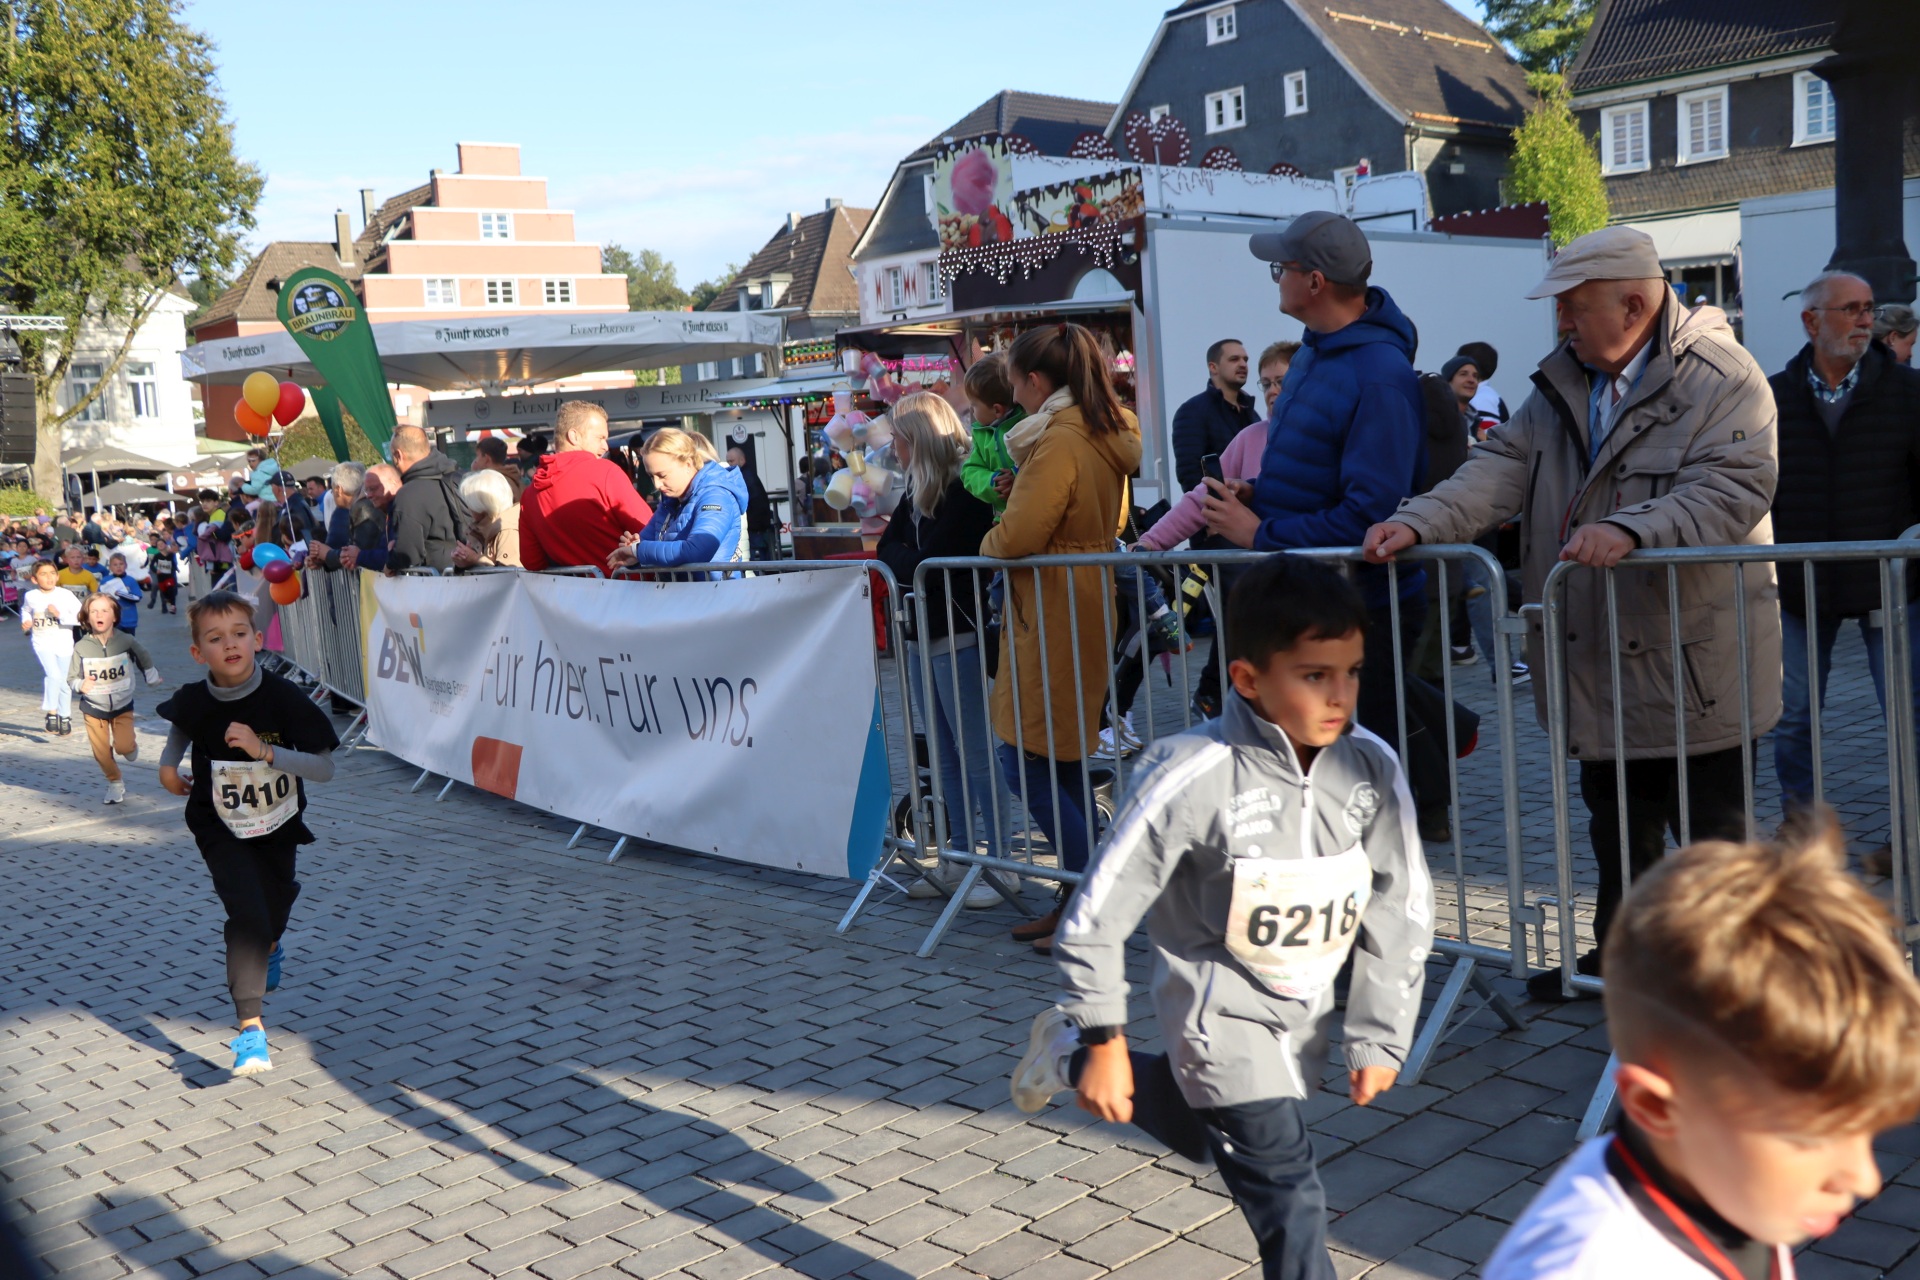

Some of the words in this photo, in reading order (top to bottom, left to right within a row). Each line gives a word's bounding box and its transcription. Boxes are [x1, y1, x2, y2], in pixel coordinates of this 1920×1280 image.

[292, 307, 353, 330] BRAUNBRÄU
[705, 320, 723, 332] KÖLSCH
[472, 326, 500, 338] KÖLSCH
[377, 627, 425, 688] BEW
[89, 665, 125, 681] 5484
[480, 637, 523, 707] Für
[530, 640, 599, 723] hier.
[598, 653, 662, 735] Für
[673, 677, 757, 748] uns.
[222, 774, 289, 810] 5410
[244, 828, 265, 836] VOSS
[1233, 819, 1273, 838] JAKO
[1247, 893, 1358, 947] 6218
